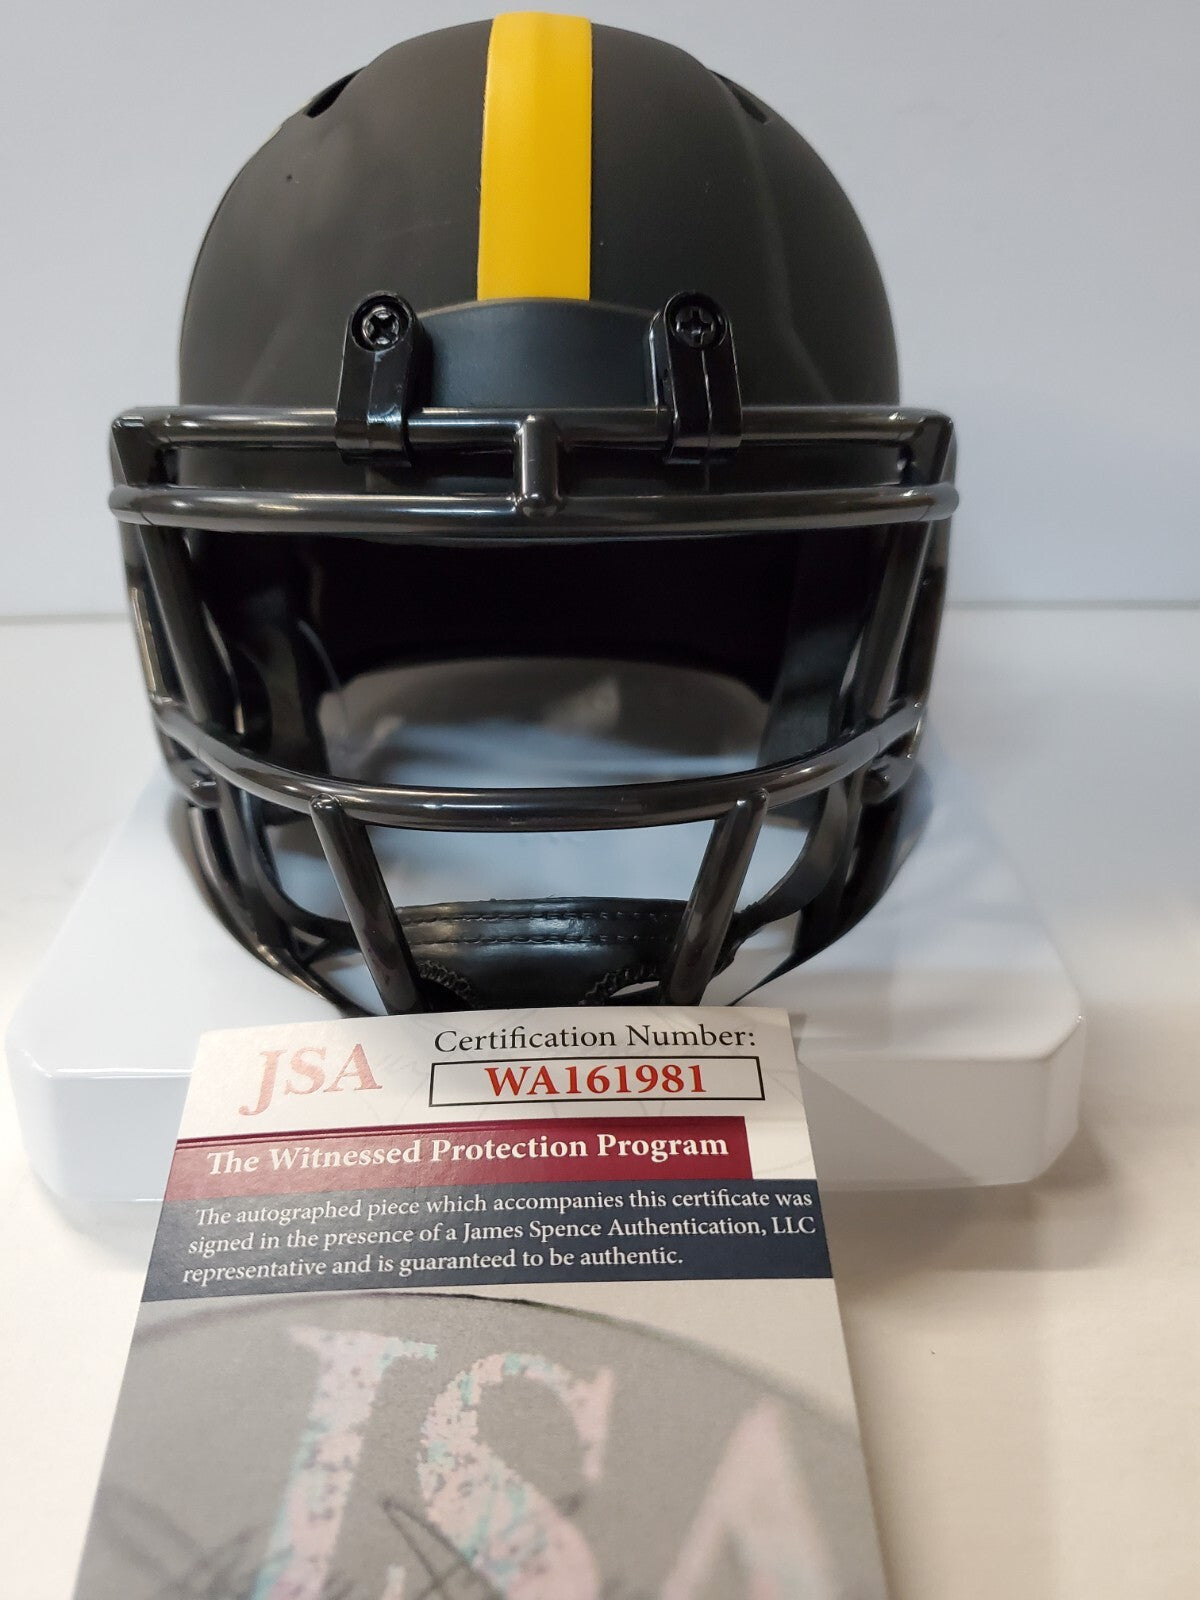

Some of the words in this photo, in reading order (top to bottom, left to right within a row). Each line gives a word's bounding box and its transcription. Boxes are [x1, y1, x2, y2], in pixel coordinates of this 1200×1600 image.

[434, 1026, 616, 1053] Certification
[627, 1024, 757, 1048] Number:
[238, 1043, 382, 1116] JSA
[484, 1063, 707, 1097] WA161981
[207, 1150, 260, 1176] The
[269, 1139, 421, 1171] Witnessed
[431, 1135, 589, 1164] Protection
[596, 1133, 729, 1163] Program
[195, 1207, 232, 1226] The
[236, 1200, 361, 1225] autographed
[367, 1200, 420, 1221] piece
[426, 1193, 488, 1213] which
[493, 1191, 623, 1215] accompanies
[628, 1189, 666, 1207] this
[671, 1189, 770, 1207] certificate
[774, 1193, 813, 1207] was
[188, 1232, 254, 1258] signed
[260, 1234, 281, 1250] in
[286, 1231, 320, 1248] the
[324, 1231, 415, 1251] presence
[419, 1223, 443, 1242] of
[445, 1228, 457, 1241] a
[462, 1222, 524, 1243] James
[528, 1220, 602, 1243] Spence
[607, 1218, 767, 1239] Authentication,
[772, 1216, 816, 1234] LLC
[182, 1259, 327, 1287] representative
[332, 1253, 372, 1273] and
[377, 1253, 394, 1271] is
[398, 1248, 517, 1277] guaranteed
[522, 1248, 545, 1266] to
[549, 1246, 575, 1265] be
[579, 1246, 684, 1264] authentic.
